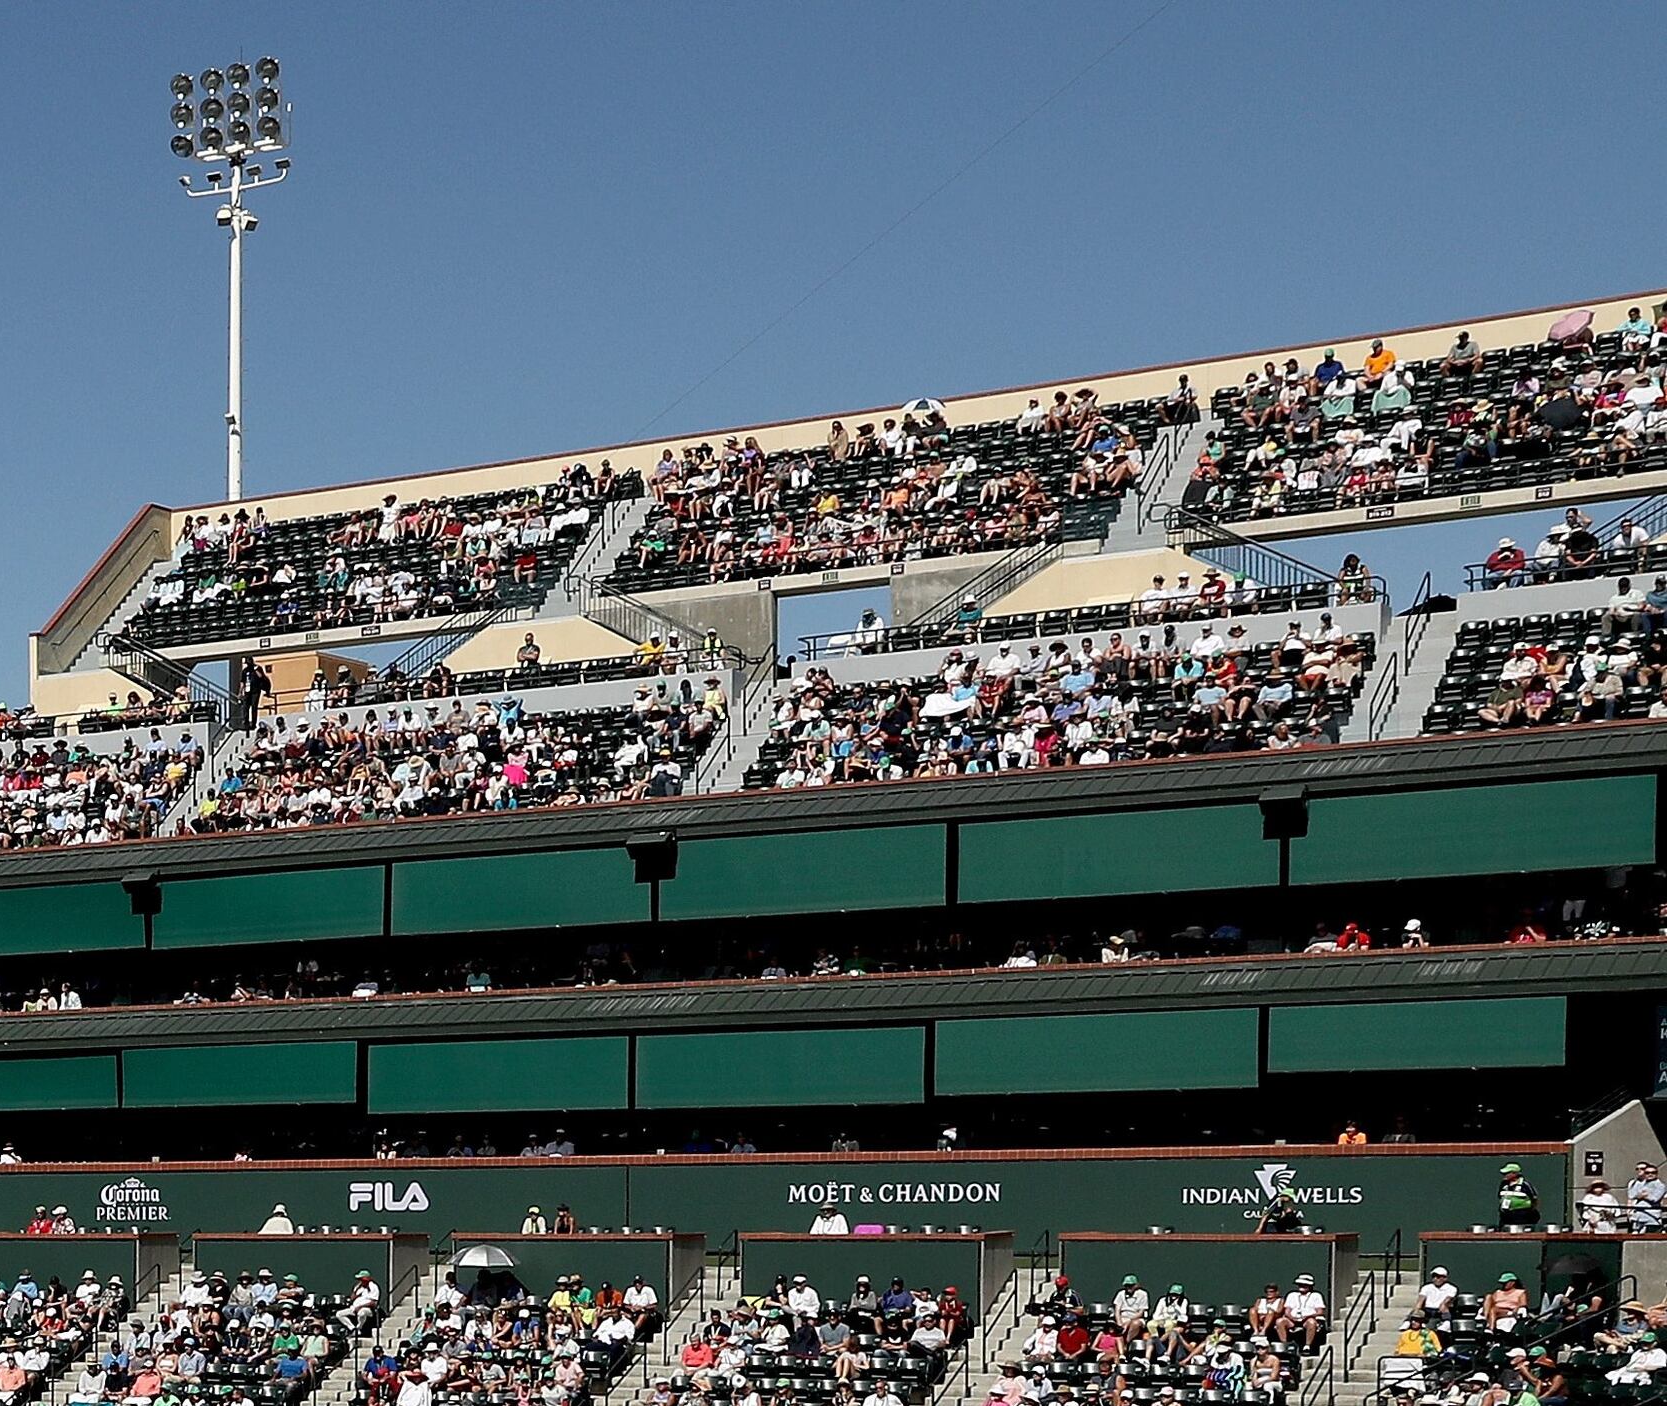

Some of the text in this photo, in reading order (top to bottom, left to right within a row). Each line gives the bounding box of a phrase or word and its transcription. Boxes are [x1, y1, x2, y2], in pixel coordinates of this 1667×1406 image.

[100, 1183, 161, 1207] Corona
[349, 1180, 430, 1213] FILA
[787, 1177, 1002, 1204] MOËT & CHANDON
[1182, 1187, 1363, 1204] INDIAN WELLS
[96, 1206, 169, 1221] PREMIER
